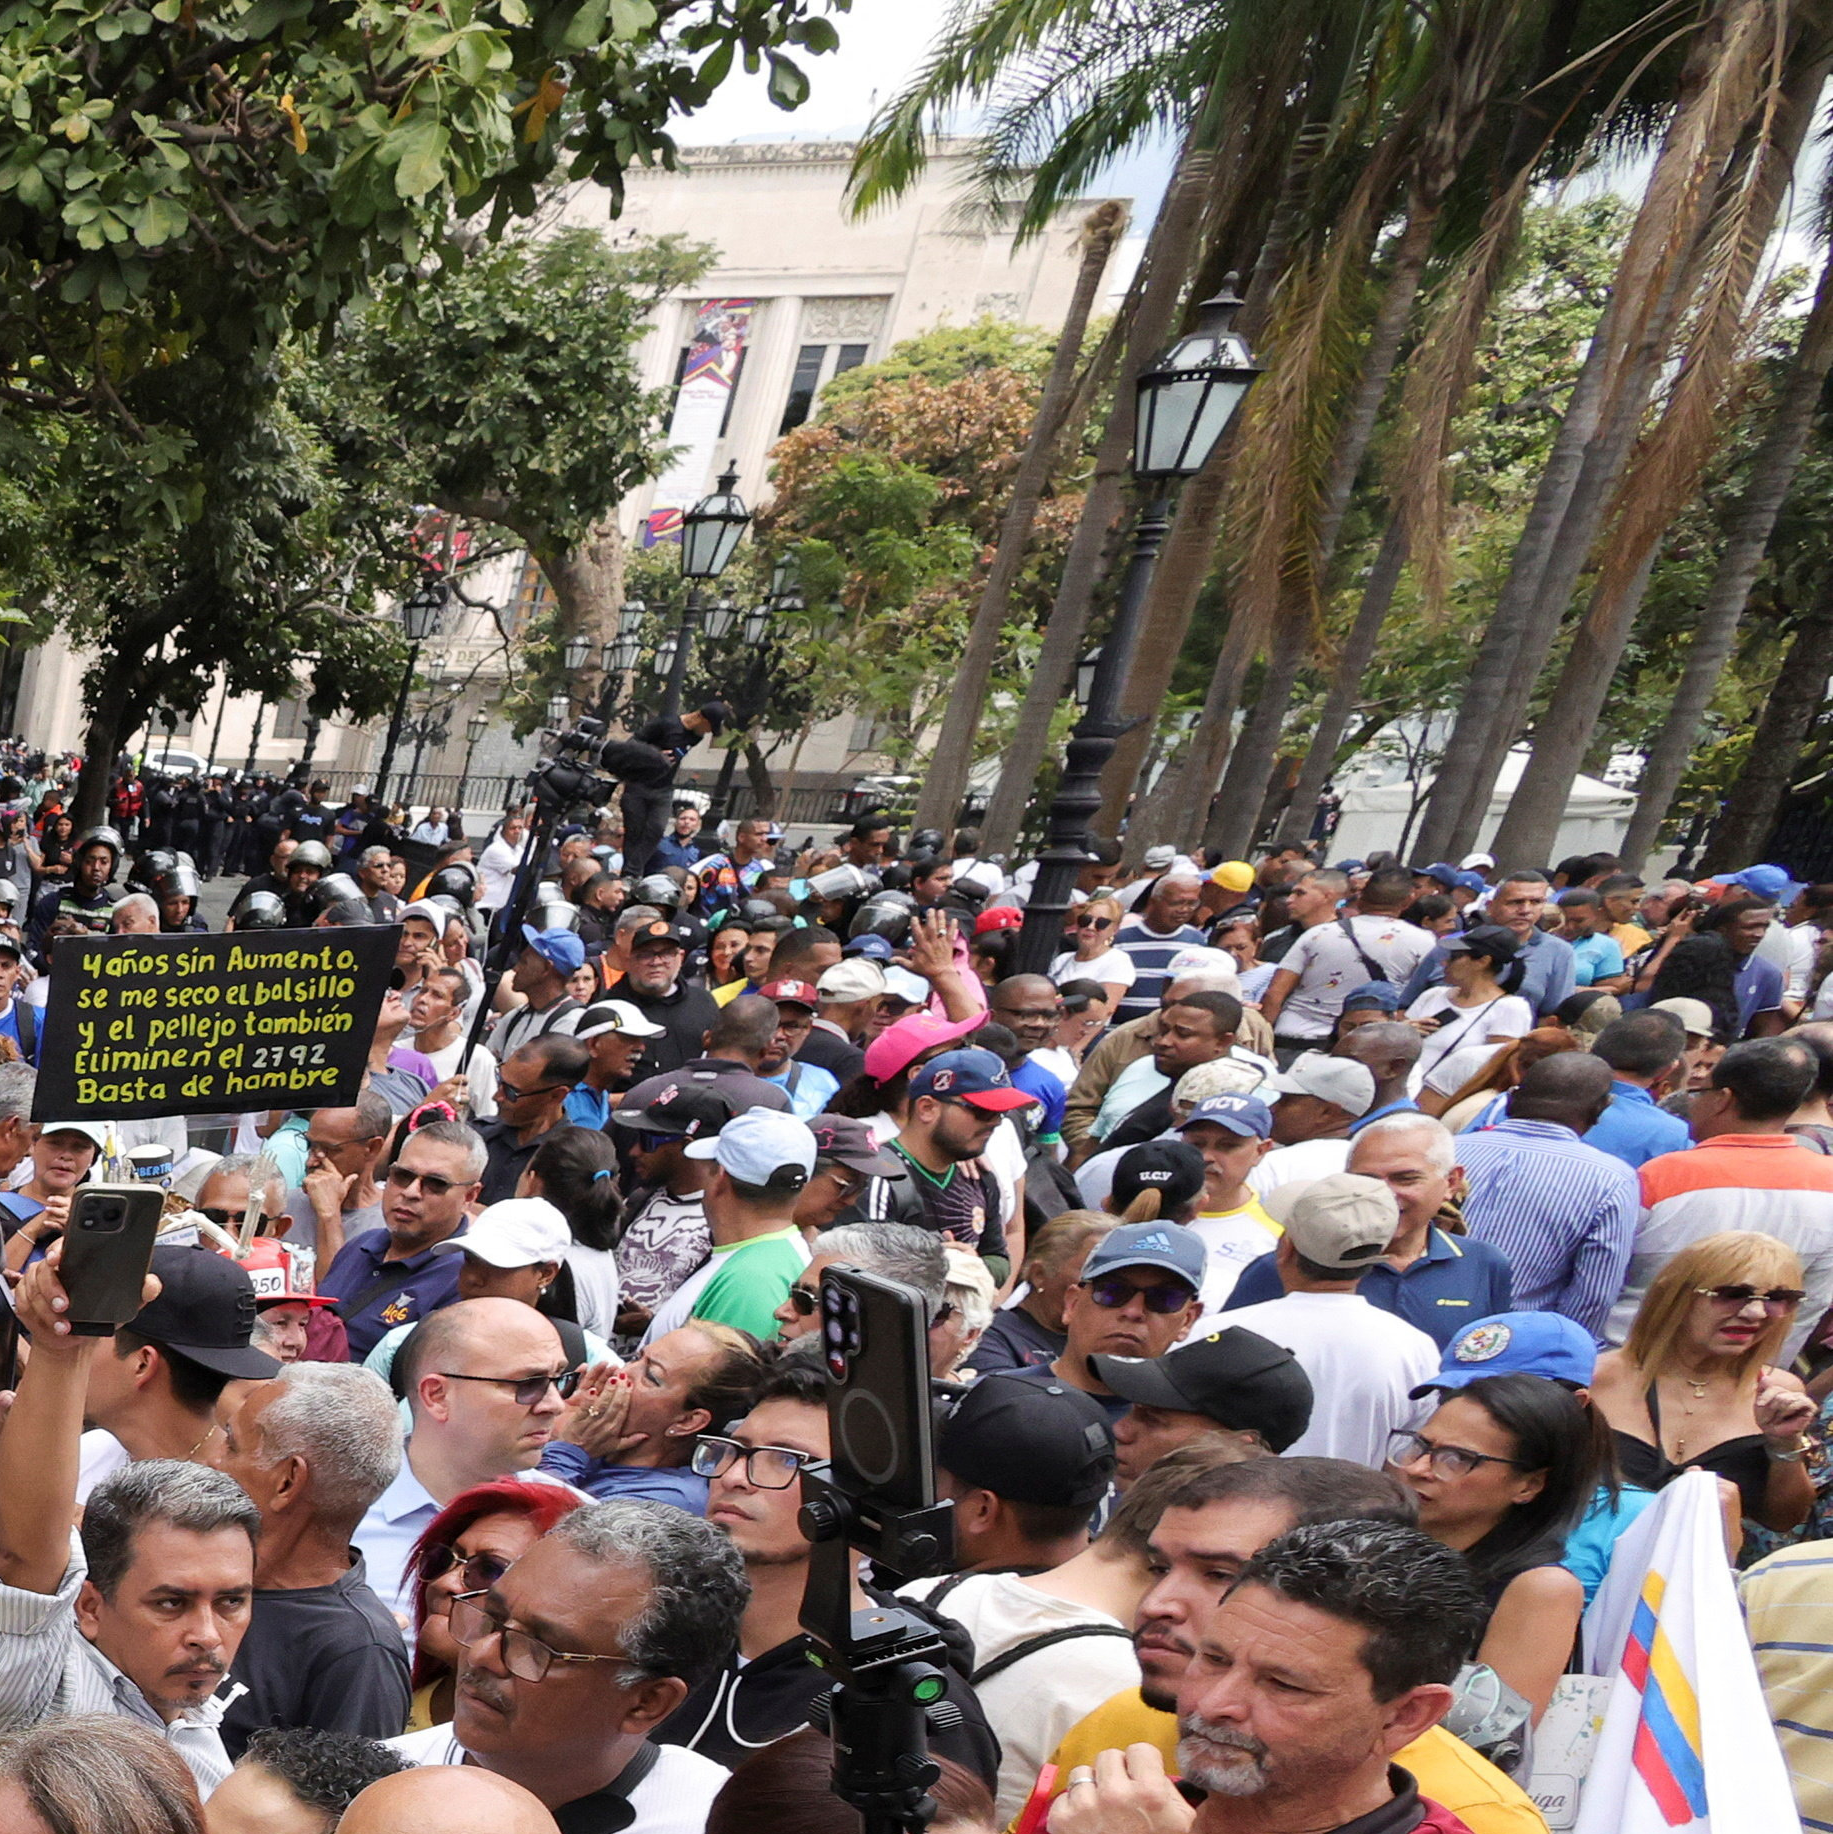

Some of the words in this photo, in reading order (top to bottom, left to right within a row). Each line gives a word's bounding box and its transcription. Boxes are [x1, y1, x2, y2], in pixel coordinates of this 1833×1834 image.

[105, 949, 169, 978] años
[176, 948, 215, 977] sin
[227, 946, 359, 974] Aumento,
[77, 988, 108, 1009] se
[121, 987, 158, 1009] me
[165, 986, 220, 1008] seco
[226, 982, 250, 1006] el
[254, 975, 355, 1006] bolsillo
[78, 1021, 94, 1050] y
[109, 1015, 135, 1041] el
[148, 1012, 237, 1048] pellejo
[244, 1004, 353, 1036] también
[74, 1046, 211, 1075] Eliminen
[218, 1043, 244, 1070] el
[253, 1043, 327, 1069] 2792
[76, 1077, 166, 1105] Basta
[181, 1075, 214, 1098] de
[226, 1067, 339, 1096] hambre
[1200, 1095, 1249, 1112] UCV
[1128, 1239, 1176, 1255] adidas
